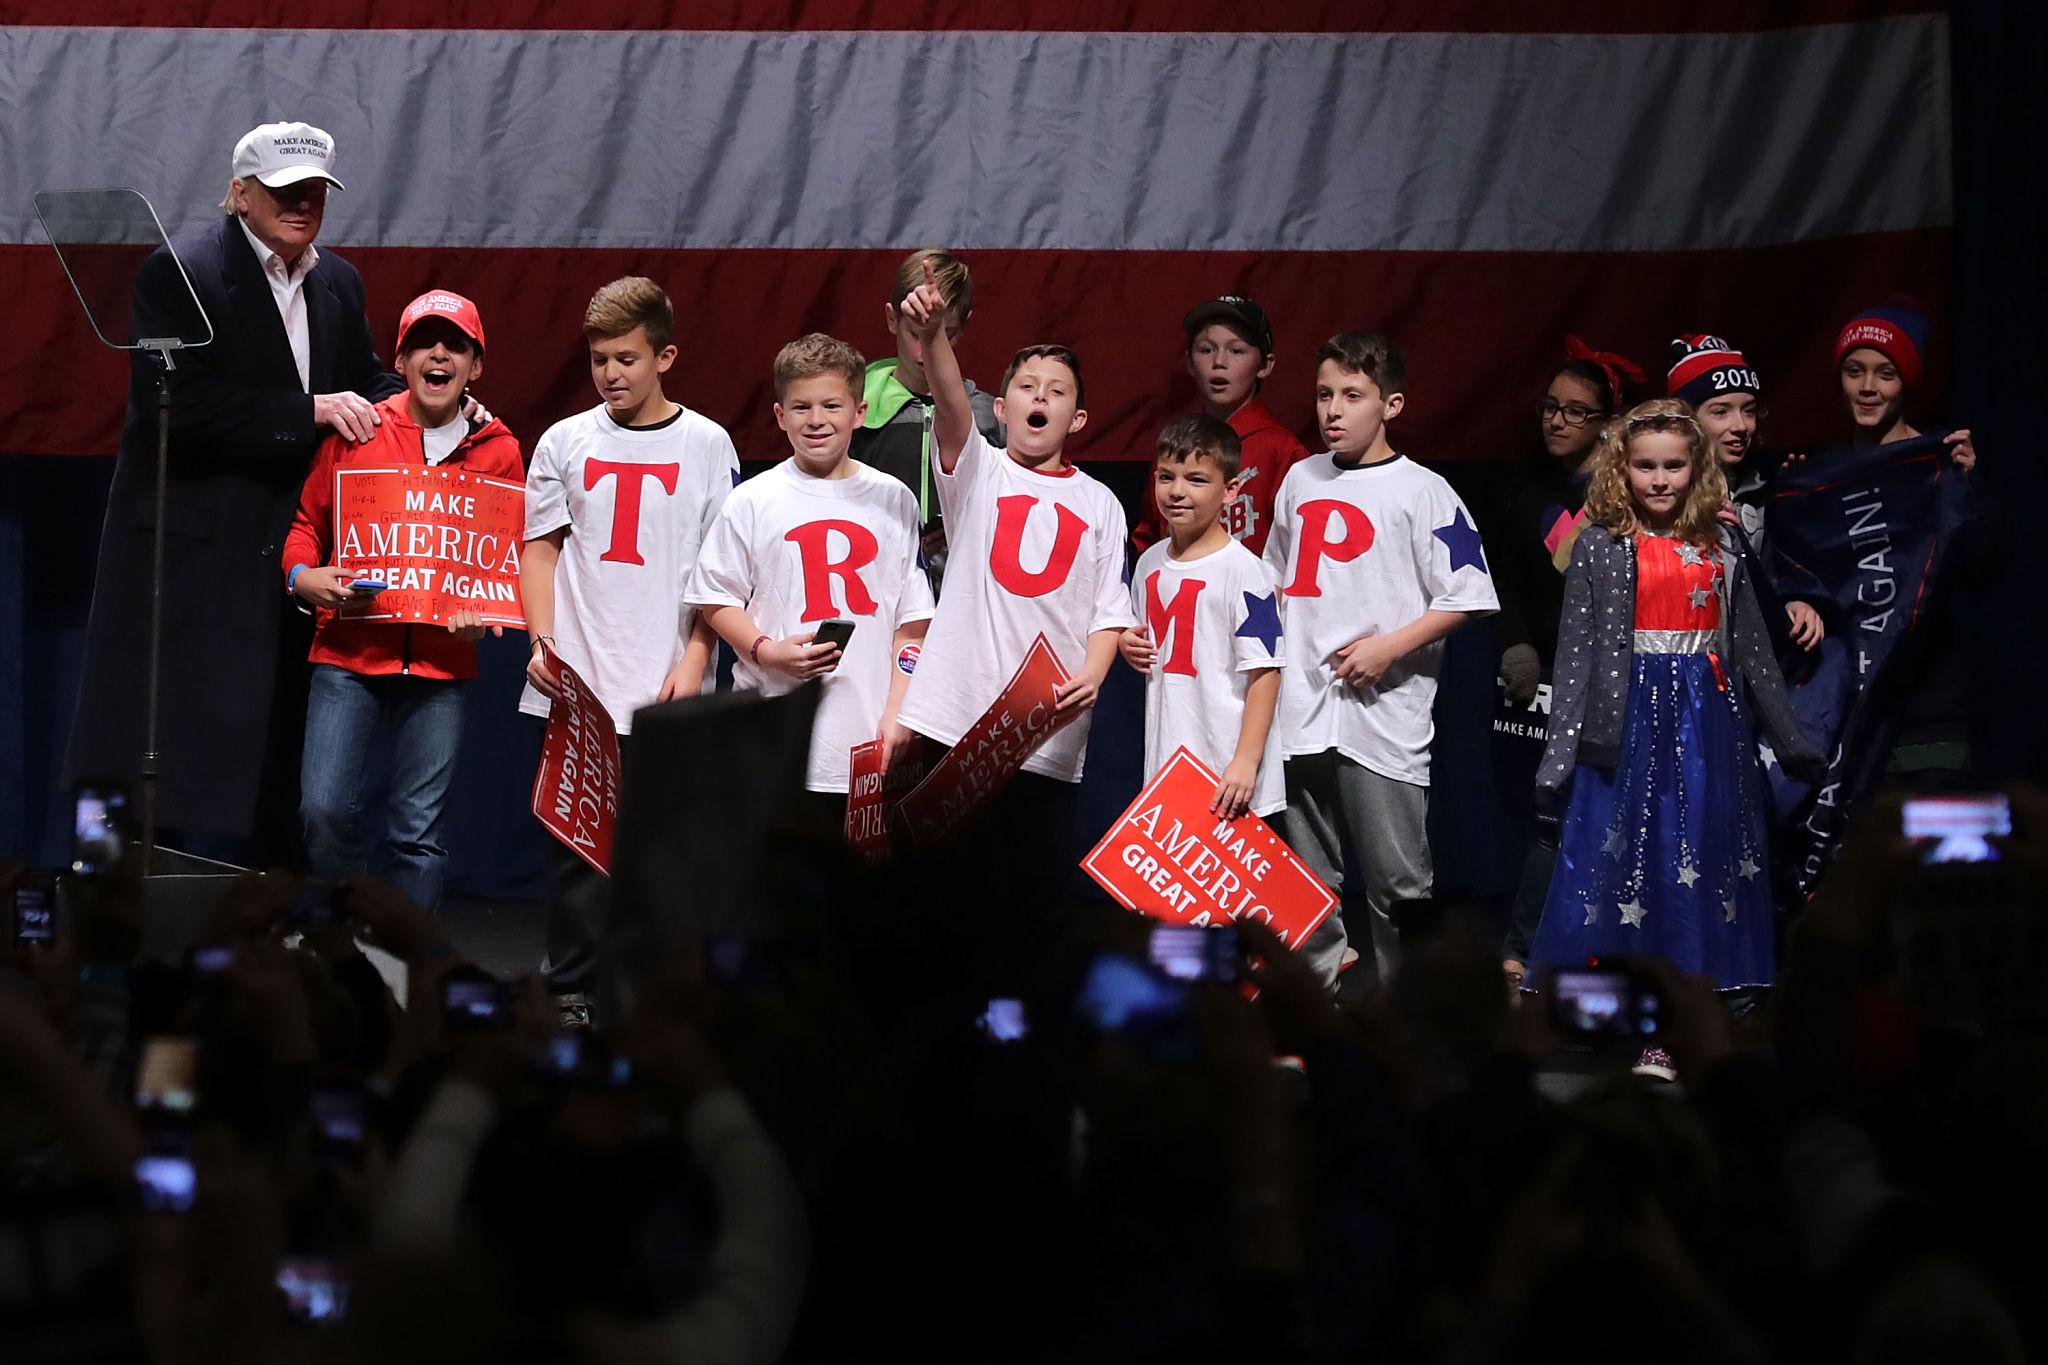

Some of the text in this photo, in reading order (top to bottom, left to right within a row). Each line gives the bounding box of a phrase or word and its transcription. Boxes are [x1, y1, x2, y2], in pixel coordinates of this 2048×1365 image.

[274, 138, 298, 146] MAKE
[280, 147, 306, 155] GREAT
[1712, 368, 1760, 390] 2016
[405, 490, 475, 518] MAKE
[584, 457, 680, 566] T
[340, 522, 521, 575] AMERICA
[784, 519, 879, 623] R
[990, 494, 1089, 597] U
[1283, 498, 1375, 597] P
[1842, 487, 1897, 633] AGAIN!
[441, 572, 516, 602] AGAIN
[1145, 570, 1206, 677] M
[958, 710, 1013, 771] MAKE
[1494, 719, 1524, 736] MAKE
[554, 739, 578, 823] AGAIN
[605, 752, 617, 819] MAKE
[1121, 844, 1197, 913] GREAT
[1211, 819, 1272, 882] MAKE
